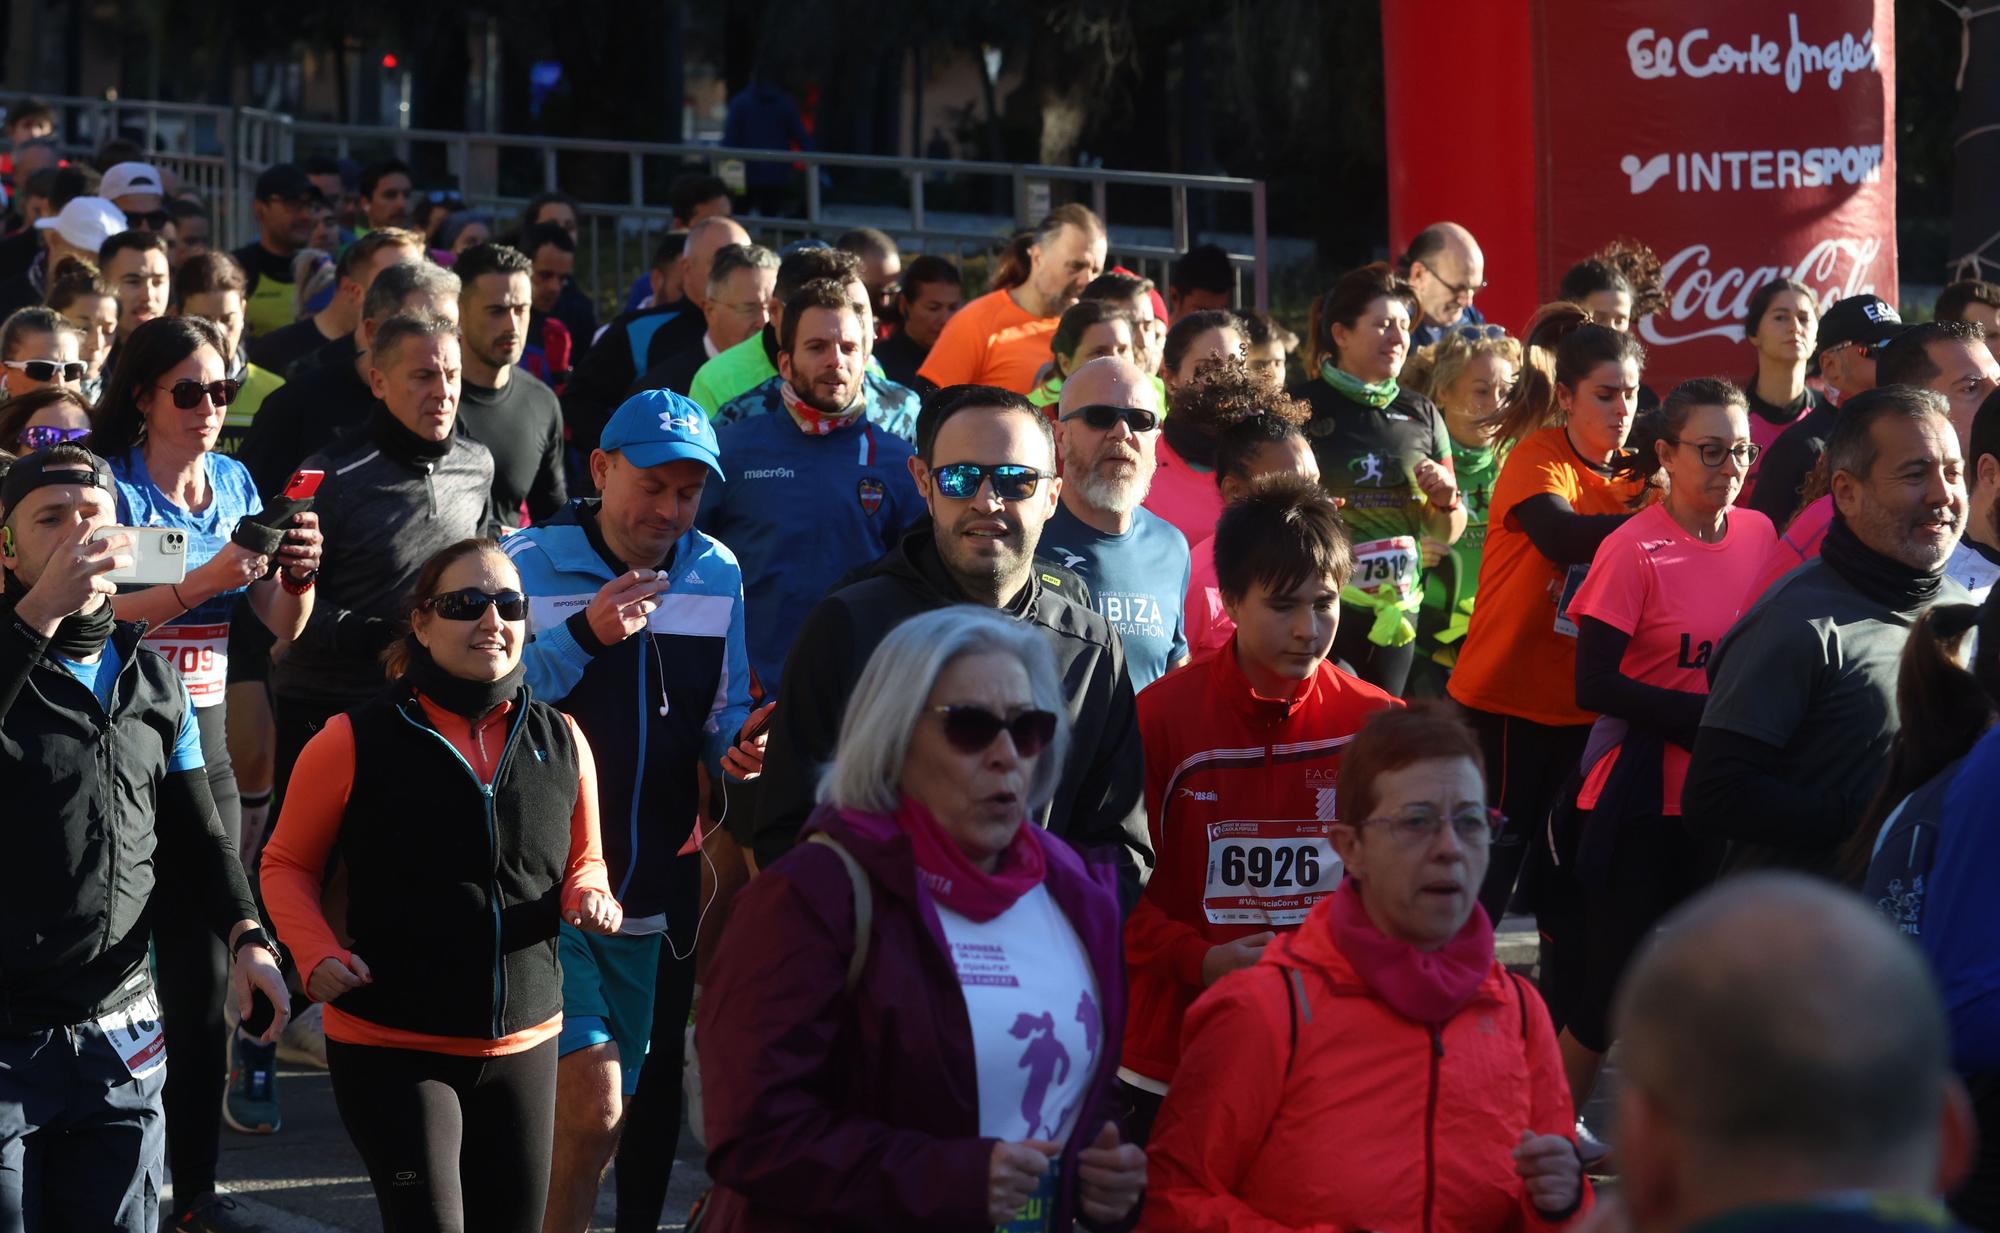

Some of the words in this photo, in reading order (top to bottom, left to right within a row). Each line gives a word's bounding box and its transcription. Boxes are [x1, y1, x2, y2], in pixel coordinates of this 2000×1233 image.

[1626, 27, 1677, 80] El
[1678, 28, 1781, 78] Corte
[1677, 144, 1882, 192] INTERSPORT
[744, 467, 795, 480] macron
[1098, 597, 1163, 625] IBIZA
[1112, 622, 1165, 638] ARATHON
[159, 645, 214, 673] 709
[1220, 845, 1320, 888] 6926
